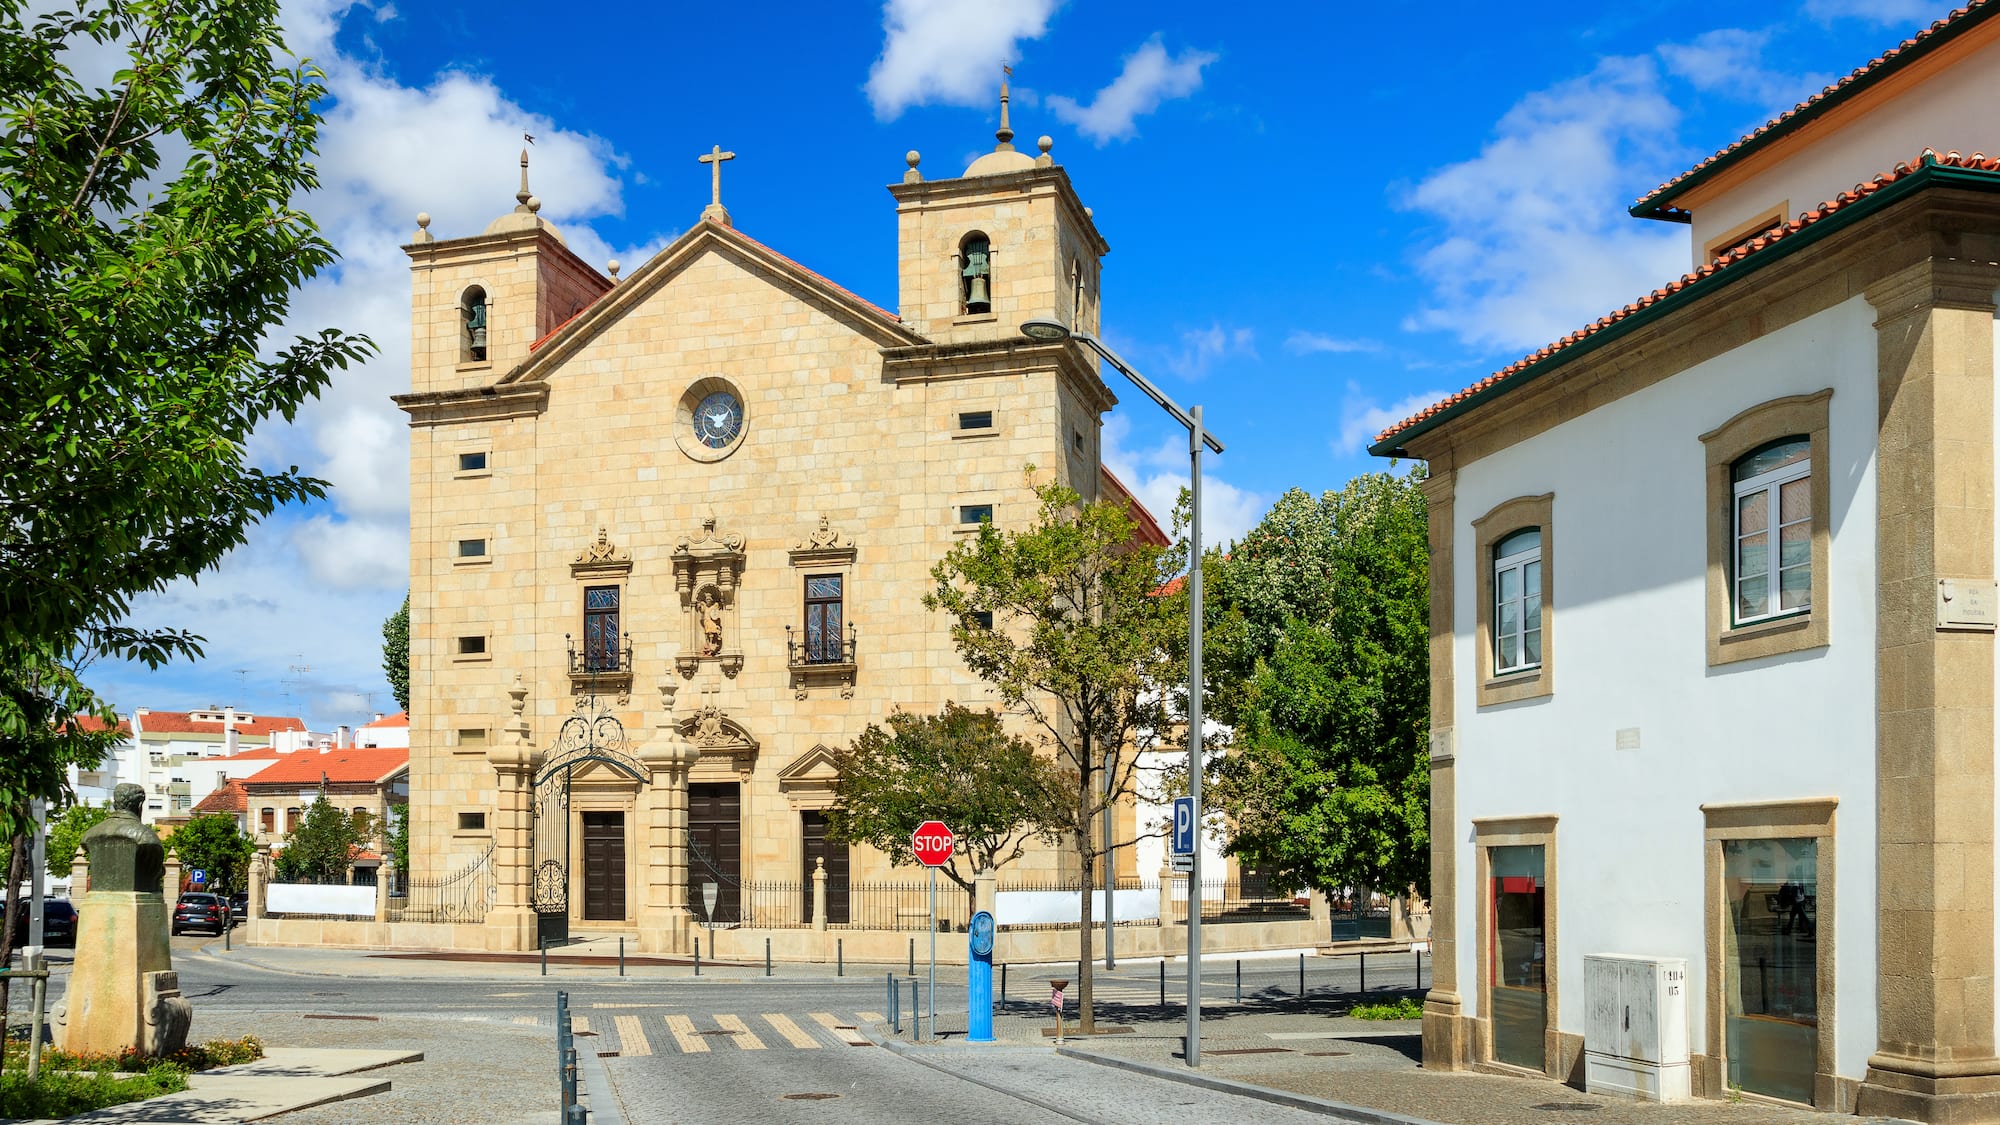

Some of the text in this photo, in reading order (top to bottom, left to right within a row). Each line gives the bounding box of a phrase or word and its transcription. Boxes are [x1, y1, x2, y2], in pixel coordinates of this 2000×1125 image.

[1178, 804, 1190, 849] P
[915, 835, 952, 852] STOP
[194, 871, 203, 882] P
